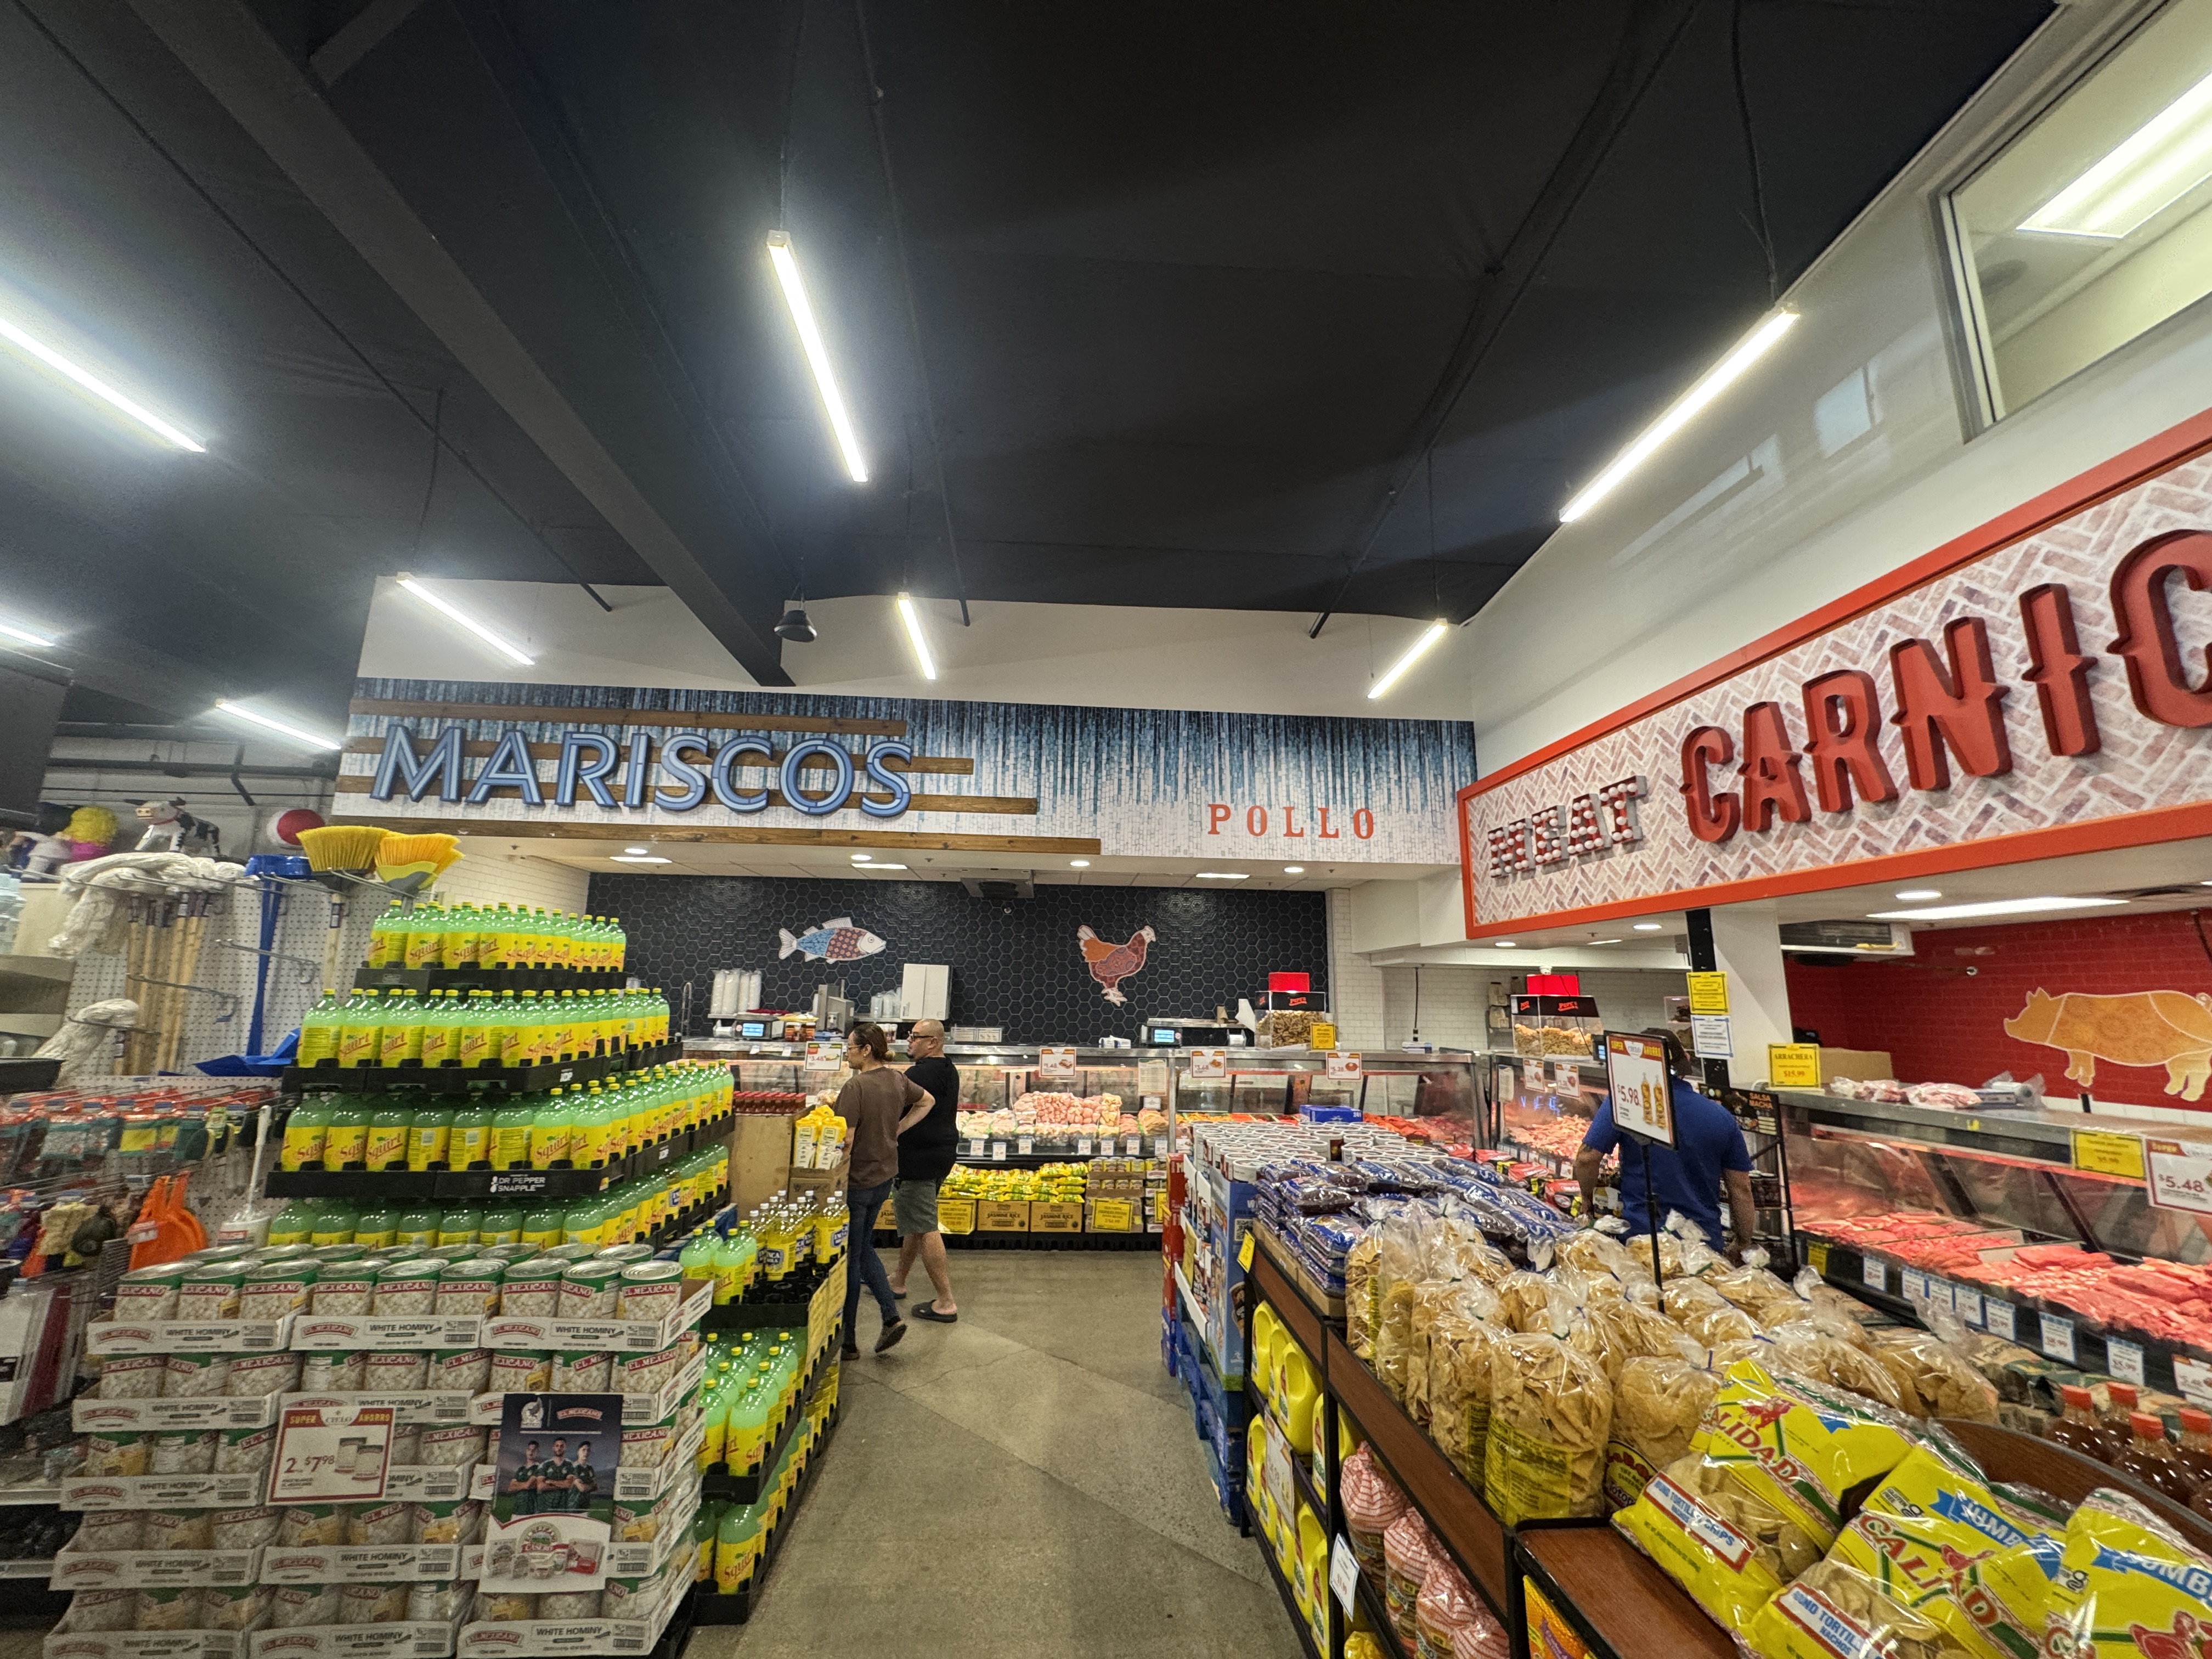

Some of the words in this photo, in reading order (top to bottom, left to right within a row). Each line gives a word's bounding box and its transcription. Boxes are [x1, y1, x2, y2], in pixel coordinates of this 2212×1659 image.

[369, 724, 912, 817] MARISCOS
[1207, 803, 1374, 840] POLLO
[1487, 775, 1646, 879] MEAT
[1617, 1083, 1639, 1106] $5.98
[535, 1131, 569, 1159] Squirt
[2158, 1173, 2205, 1193] $5.48
[556, 1326, 582, 1334] WHITE
[583, 1327, 616, 1335] HOMINY
[537, 1627, 565, 1637] WHITE
[566, 1627, 602, 1636] HOMINY
